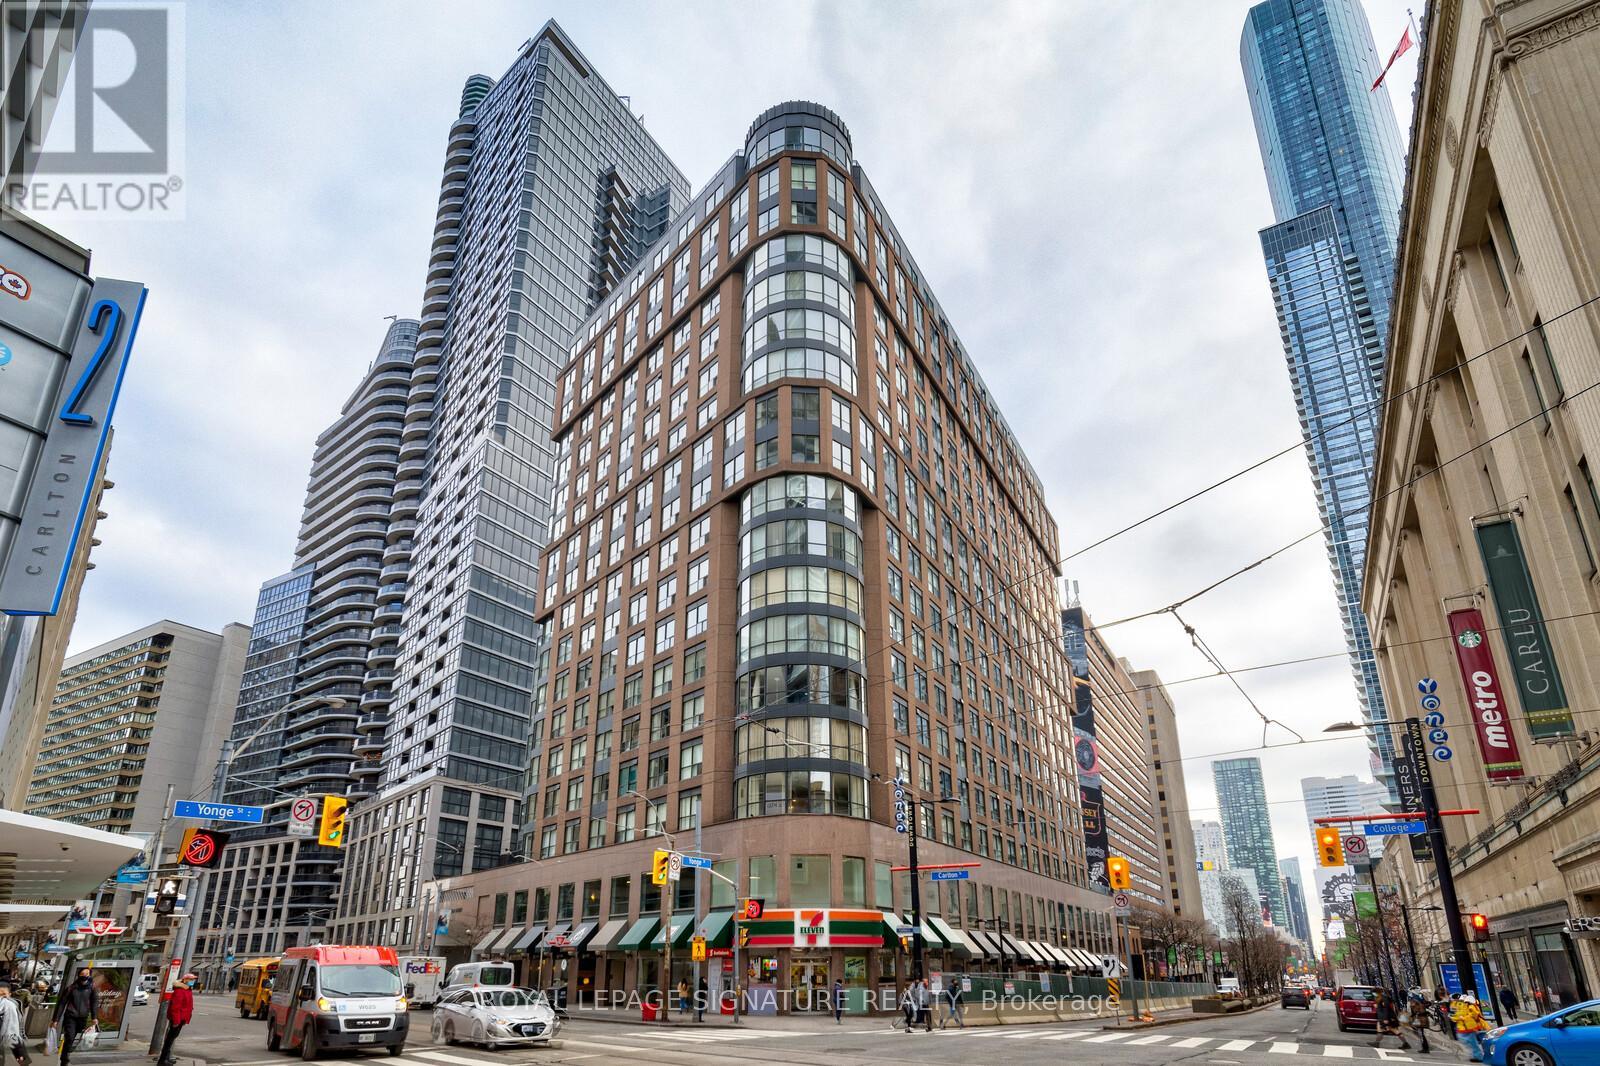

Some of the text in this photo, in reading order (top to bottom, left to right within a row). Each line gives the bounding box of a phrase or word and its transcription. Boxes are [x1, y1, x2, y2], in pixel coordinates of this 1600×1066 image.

[60, 299, 121, 425] 2
[25, 453, 76, 576] CARLTON
[1507, 607, 1550, 695] CARLU
[1471, 670, 1510, 749] metro
[1411, 722, 1430, 783] DOWNTOWN
[197, 804, 234, 819] Yonge
[1373, 824, 1409, 834] College
[1398, 764, 1424, 838] INNERS
[801, 910, 824, 945] 7
[405, 962, 441, 975] FedEx
